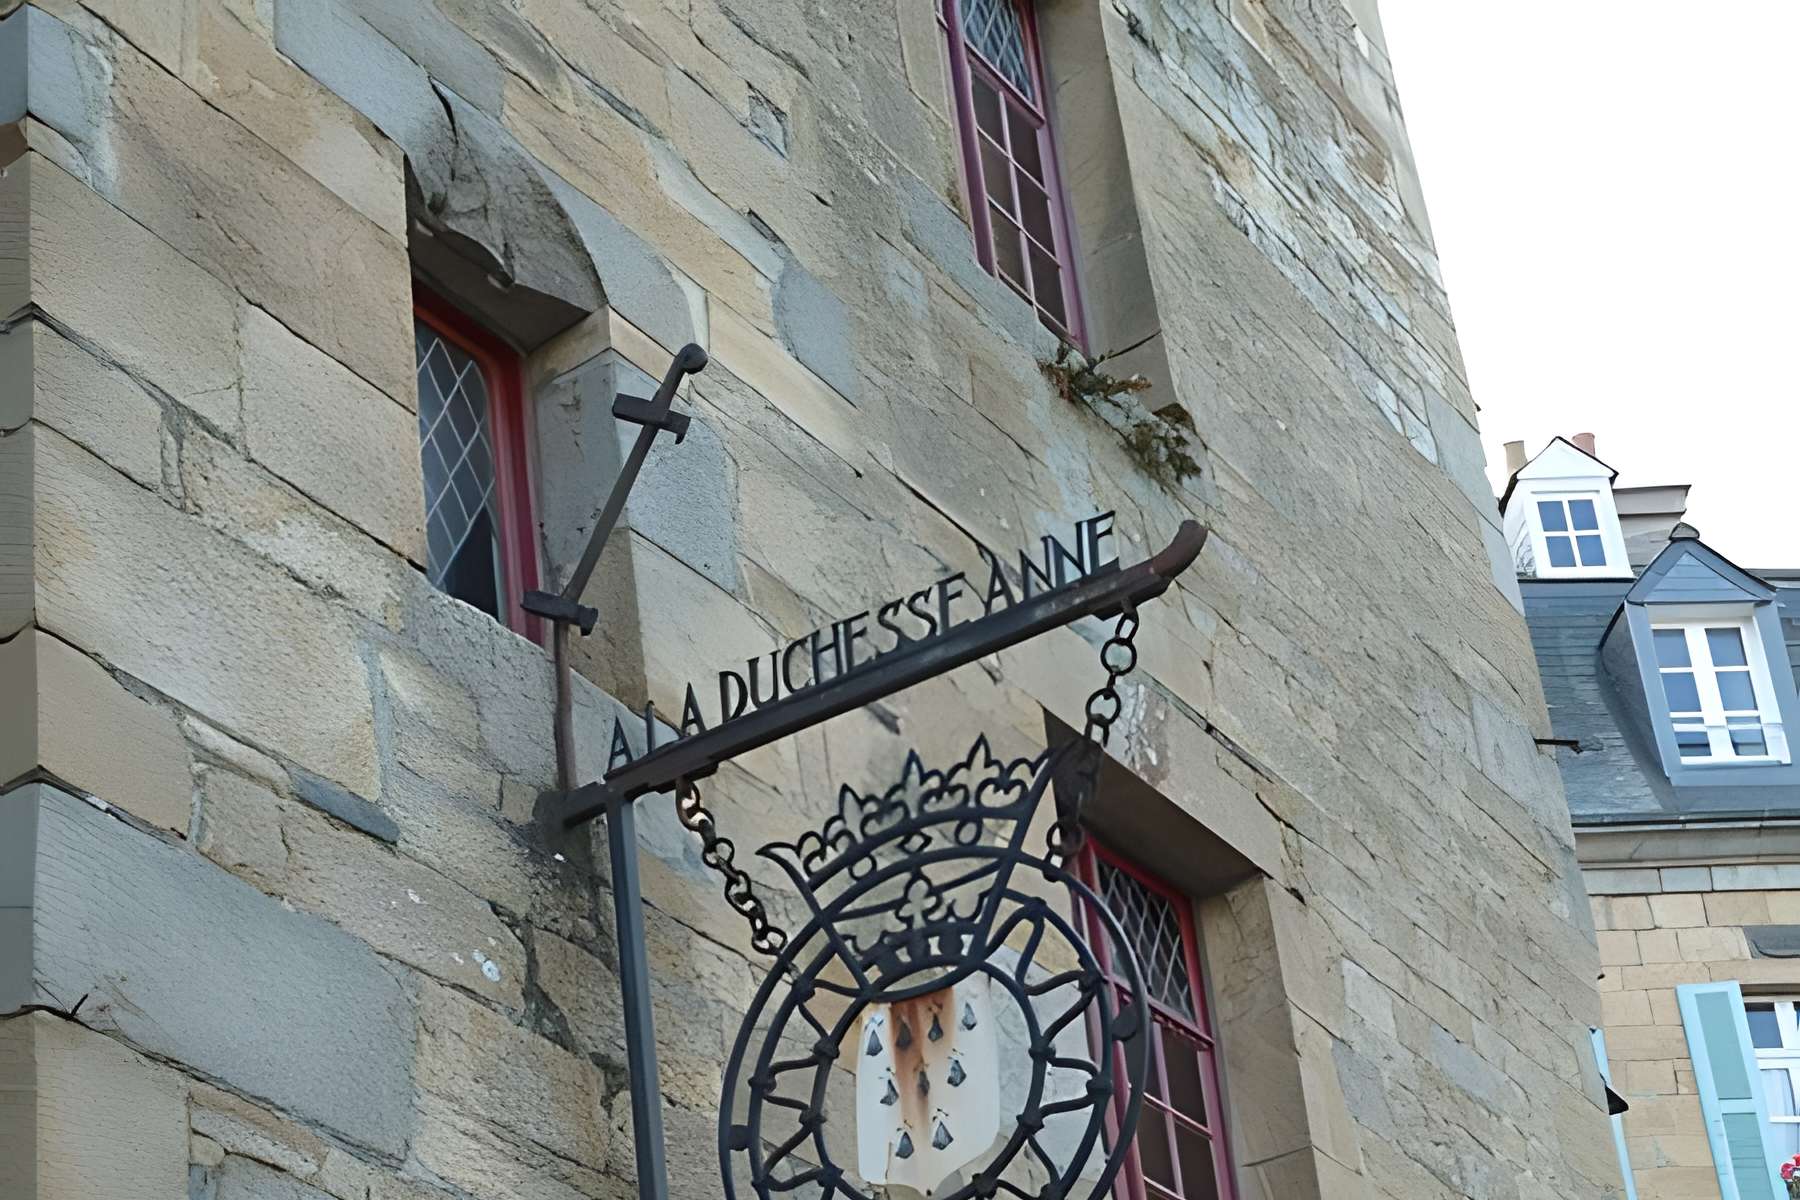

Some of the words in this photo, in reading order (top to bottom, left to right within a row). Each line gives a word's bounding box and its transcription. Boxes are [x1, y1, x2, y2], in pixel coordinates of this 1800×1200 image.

[608, 715, 633, 771] A
[718, 570, 972, 723] DUCHESSE
[979, 510, 1120, 617] ANNE
